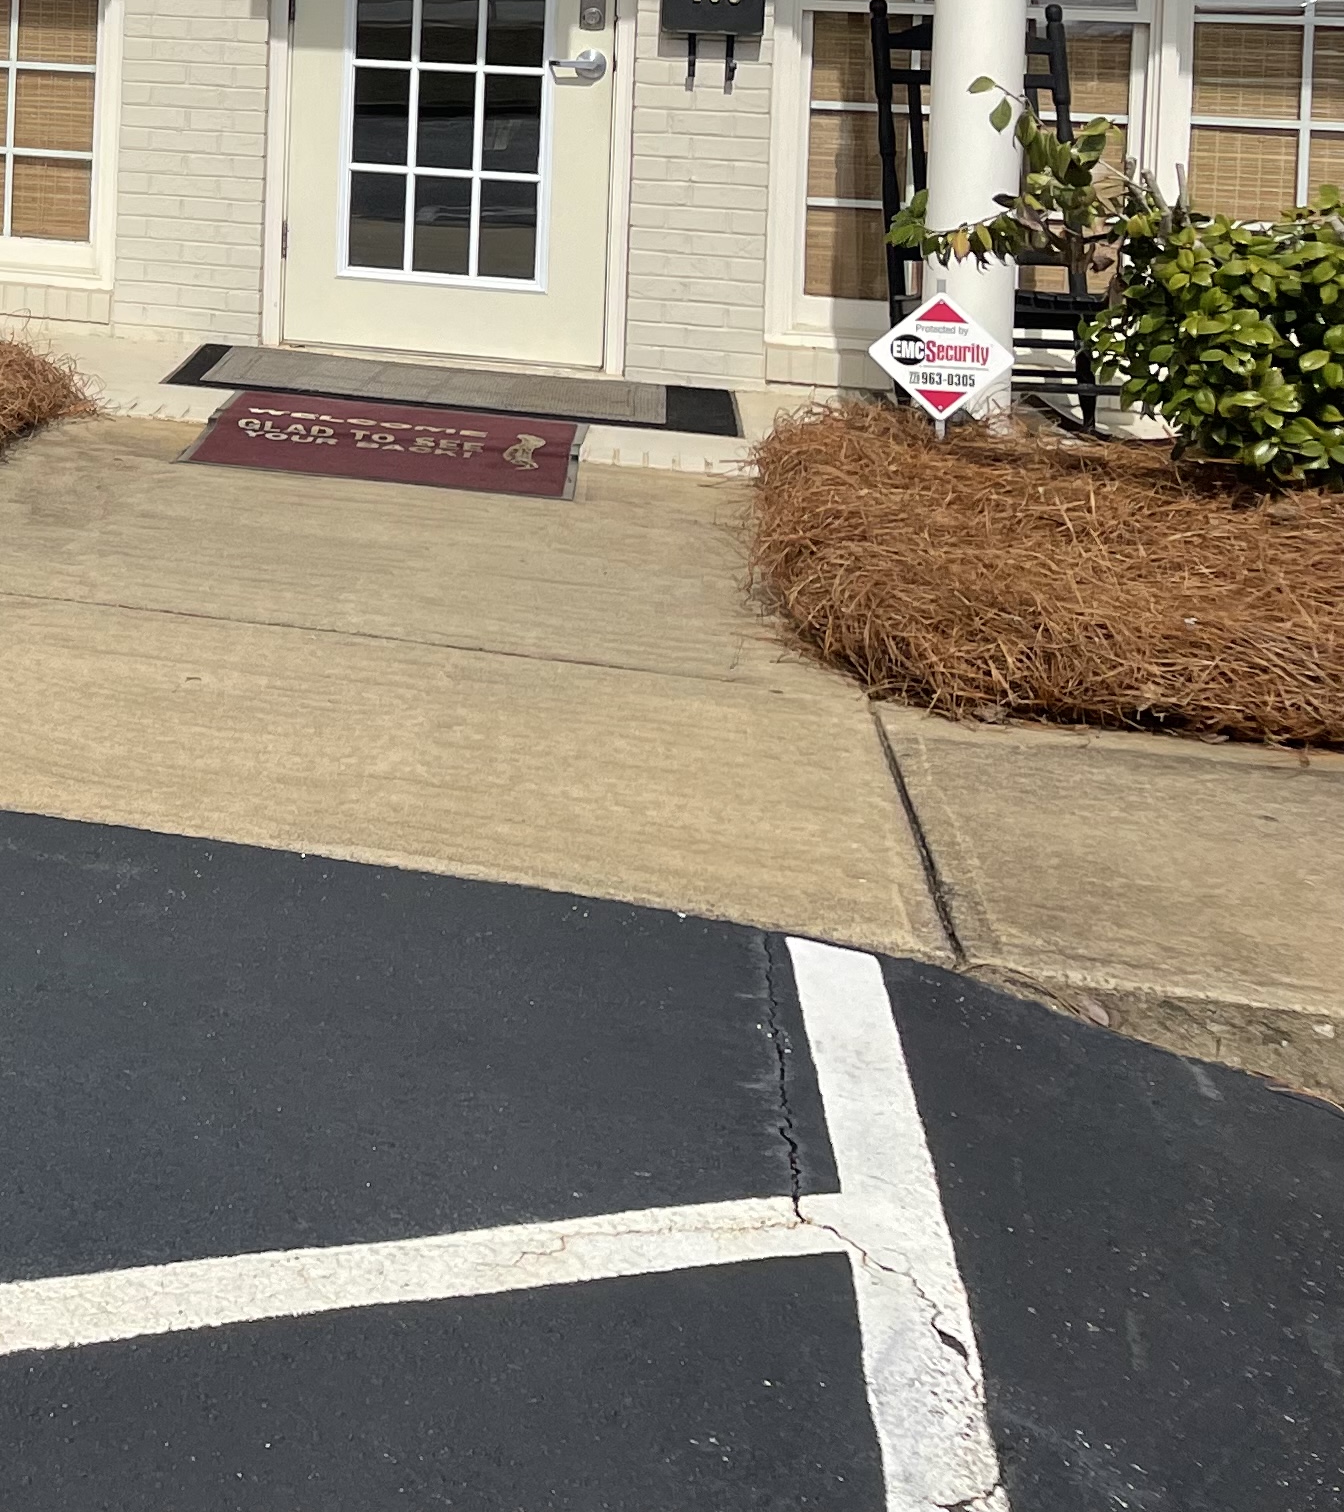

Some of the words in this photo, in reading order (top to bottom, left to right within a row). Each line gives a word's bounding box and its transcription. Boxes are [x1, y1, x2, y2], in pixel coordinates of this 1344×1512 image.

[915, 323, 956, 335] Protected
[958, 326, 969, 337] by
[892, 340, 925, 360] EMC
[926, 340, 990, 367] Security
[921, 372, 976, 387] 963-0305
[237, 418, 335, 437] GLAD
[349, 429, 396, 443] TO
[413, 437, 485, 454] SEE
[248, 407, 489, 438] WELCOME
[245, 430, 339, 445] YOUR
[355, 441, 473, 459] BACK!
